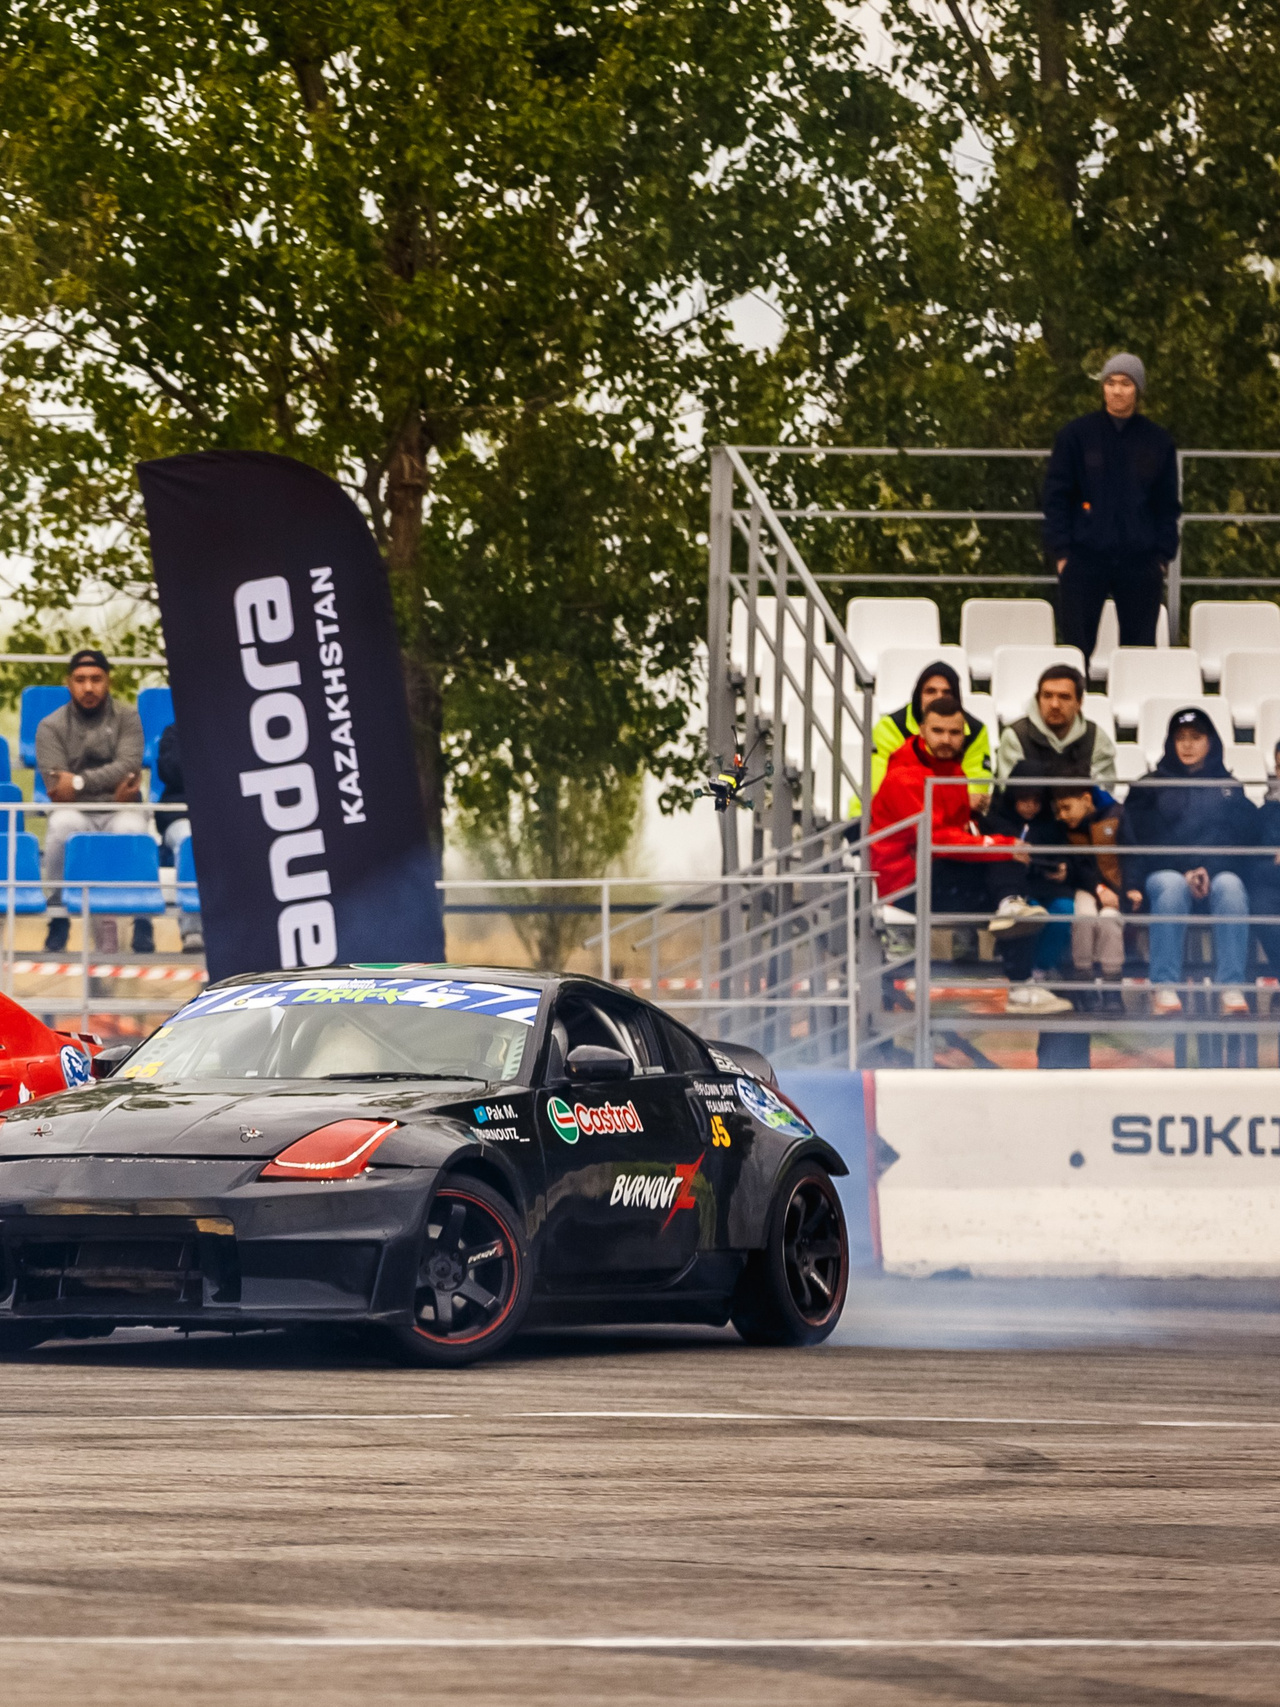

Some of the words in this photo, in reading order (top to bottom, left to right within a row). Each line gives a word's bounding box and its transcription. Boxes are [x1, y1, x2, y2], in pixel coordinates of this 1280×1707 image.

[310, 566, 366, 824] KAZAKHSTAN
[292, 988, 406, 1005] DRIFT
[485, 1104, 505, 1120] Pak
[503, 1104, 518, 1119] M.
[574, 1100, 644, 1136] Castrol
